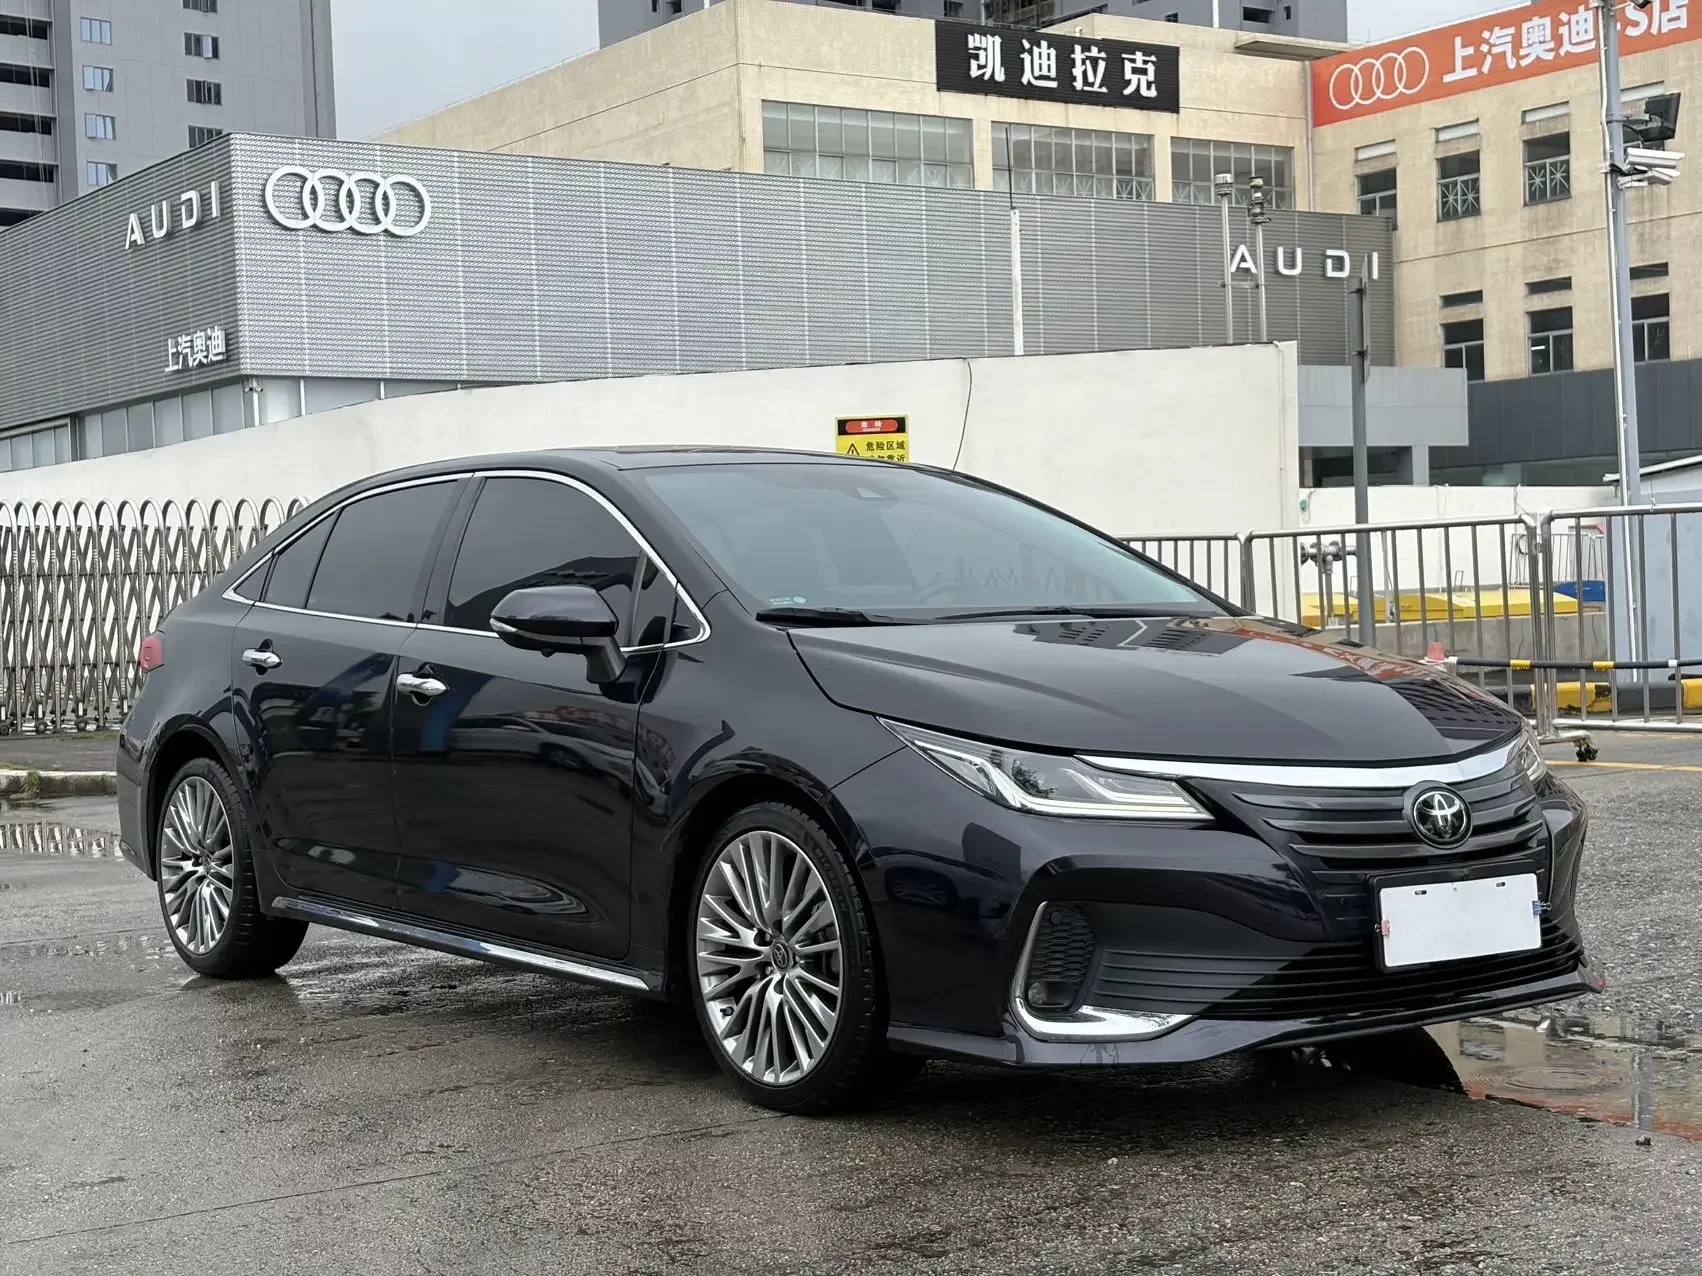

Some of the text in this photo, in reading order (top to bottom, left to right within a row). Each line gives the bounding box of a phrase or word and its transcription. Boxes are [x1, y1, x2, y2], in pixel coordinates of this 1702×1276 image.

[967, 32, 1158, 98] 凯迪拉克
[1442, 0, 1689, 83] 上汽奥迪S店
[125, 180, 221, 250] AUDI
[1230, 244, 1379, 280] AUDI
[164, 325, 227, 373] 上汽奥迪
[866, 441, 905, 451] 危险区域
